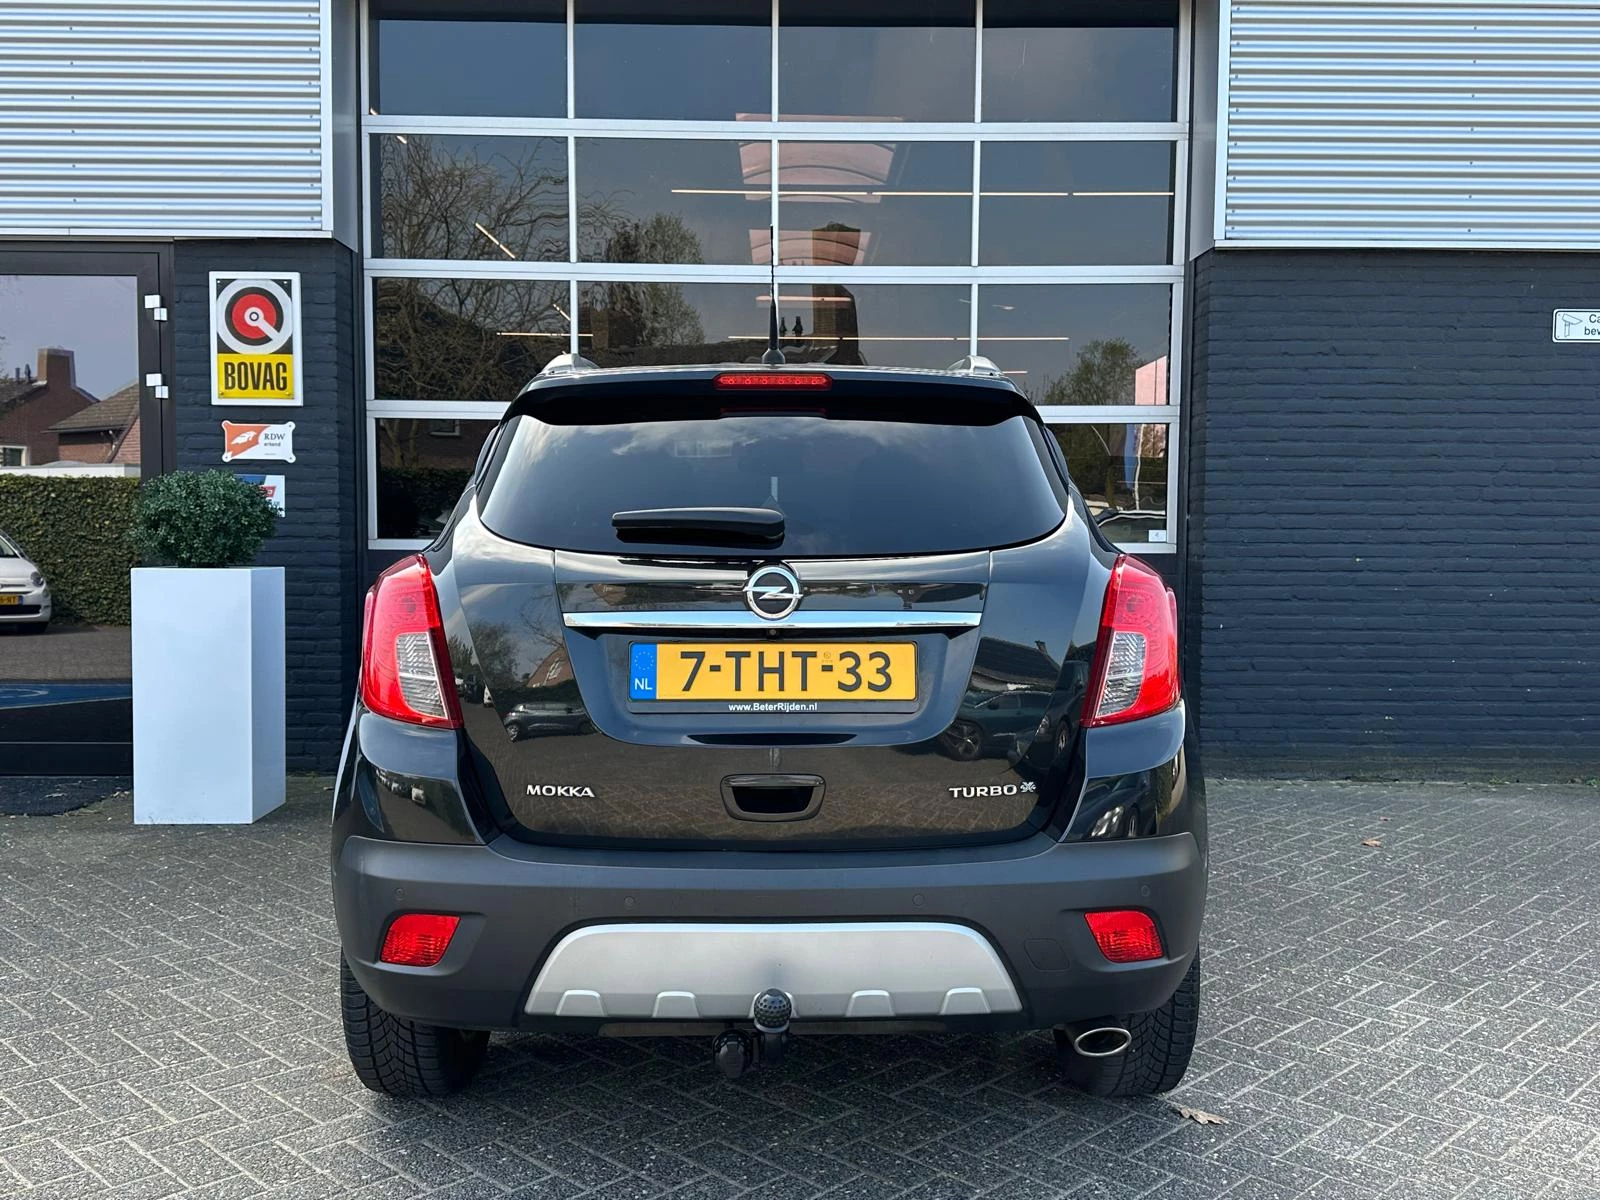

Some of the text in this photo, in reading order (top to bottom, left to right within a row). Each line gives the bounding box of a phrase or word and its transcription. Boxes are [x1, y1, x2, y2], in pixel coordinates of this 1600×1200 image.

[224, 362, 287, 391] BOVAG
[264, 433, 286, 441] RDW
[680, 651, 892, 692] 7-THT-33
[634, 678, 652, 690] NL
[728, 702, 818, 712] www.BeterRijden.nl
[526, 784, 595, 798] MOKKA
[948, 784, 1018, 798] TURBO
